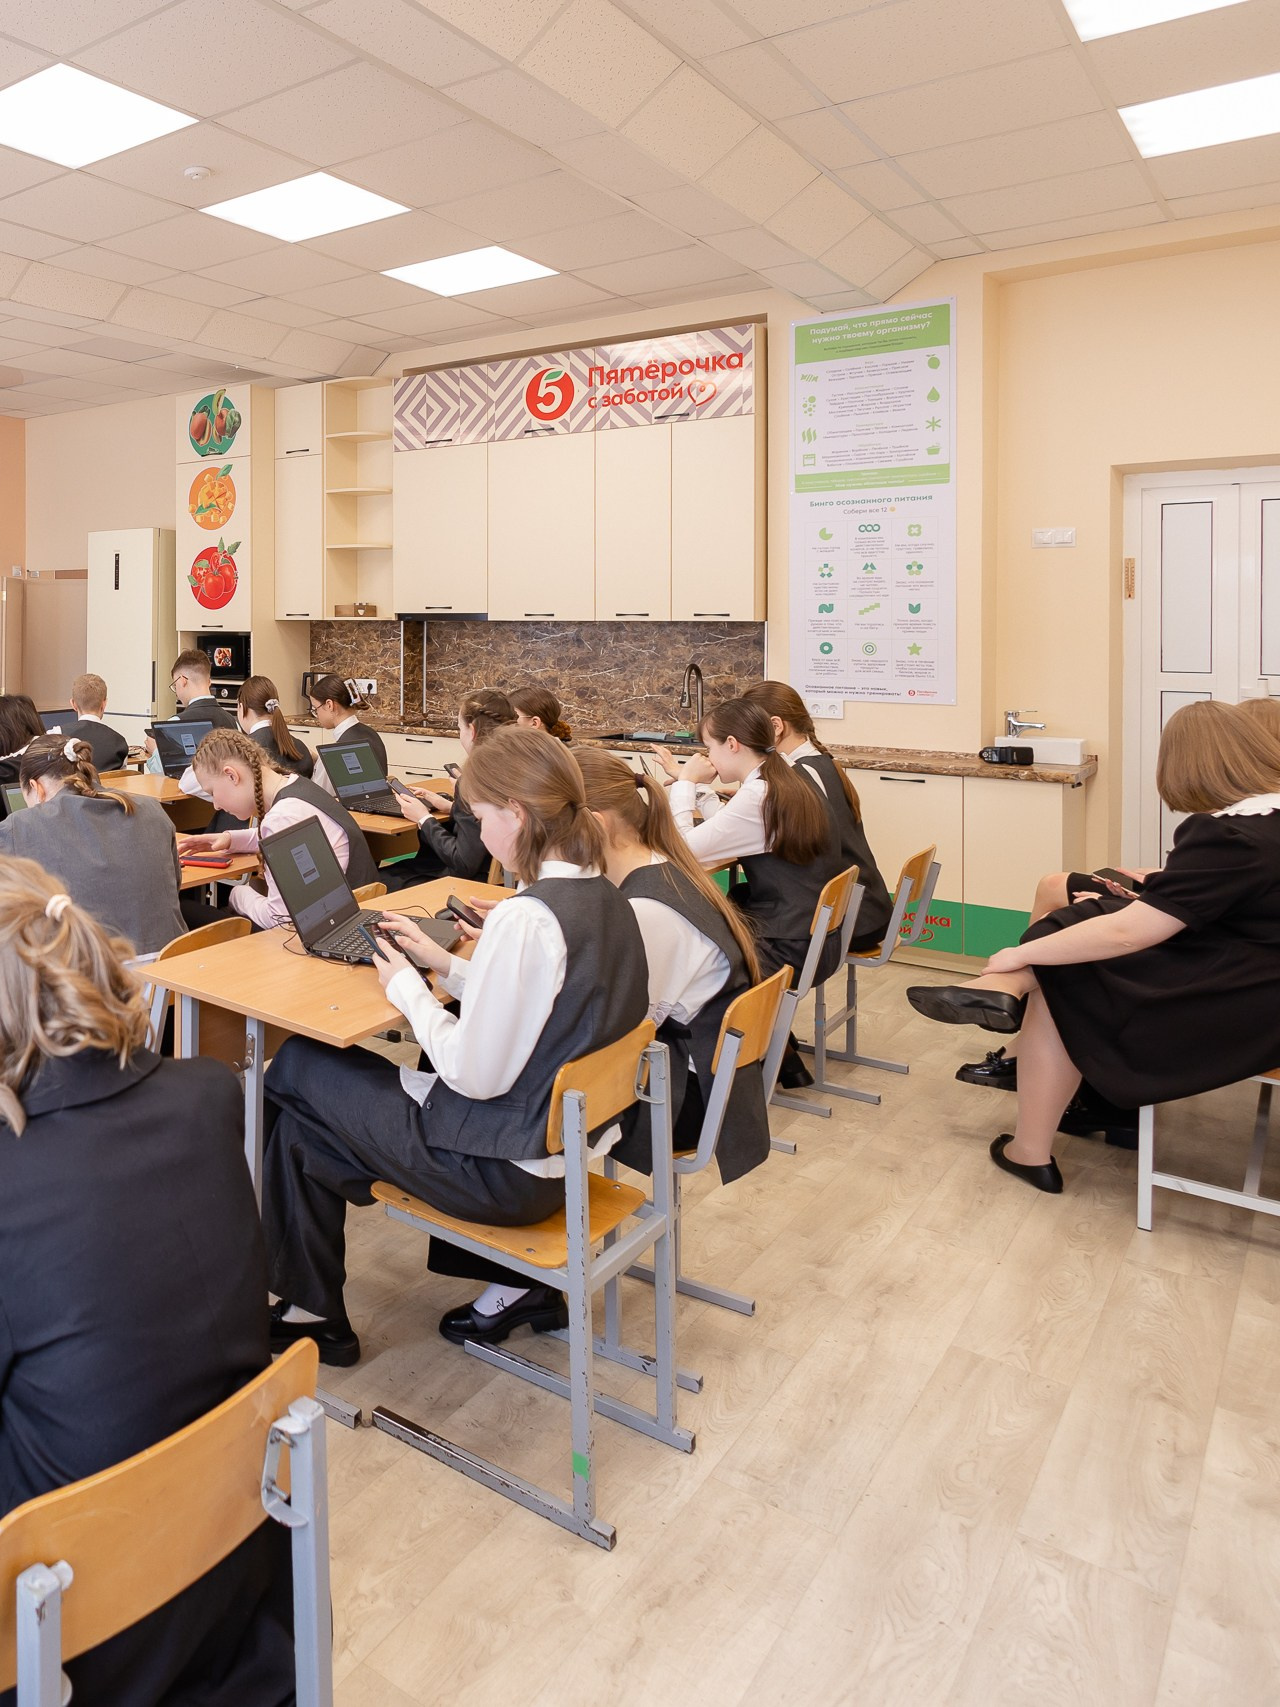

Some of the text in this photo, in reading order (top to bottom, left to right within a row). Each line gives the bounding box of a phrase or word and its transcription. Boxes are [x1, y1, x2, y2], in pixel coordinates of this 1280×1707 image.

[811, 325, 851, 336] Подумай,
[869, 317, 899, 328] прямо
[900, 312, 933, 323] сейчас
[812, 335, 841, 345] нужно
[842, 330, 875, 340] твоему
[876, 322, 931, 337] организму?
[587, 351, 744, 389] Пятёрочка
[587, 382, 684, 409] с заботой
[836, 497, 892, 506] осознанного
[894, 494, 934, 503] питания
[843, 508, 868, 516] Собери
